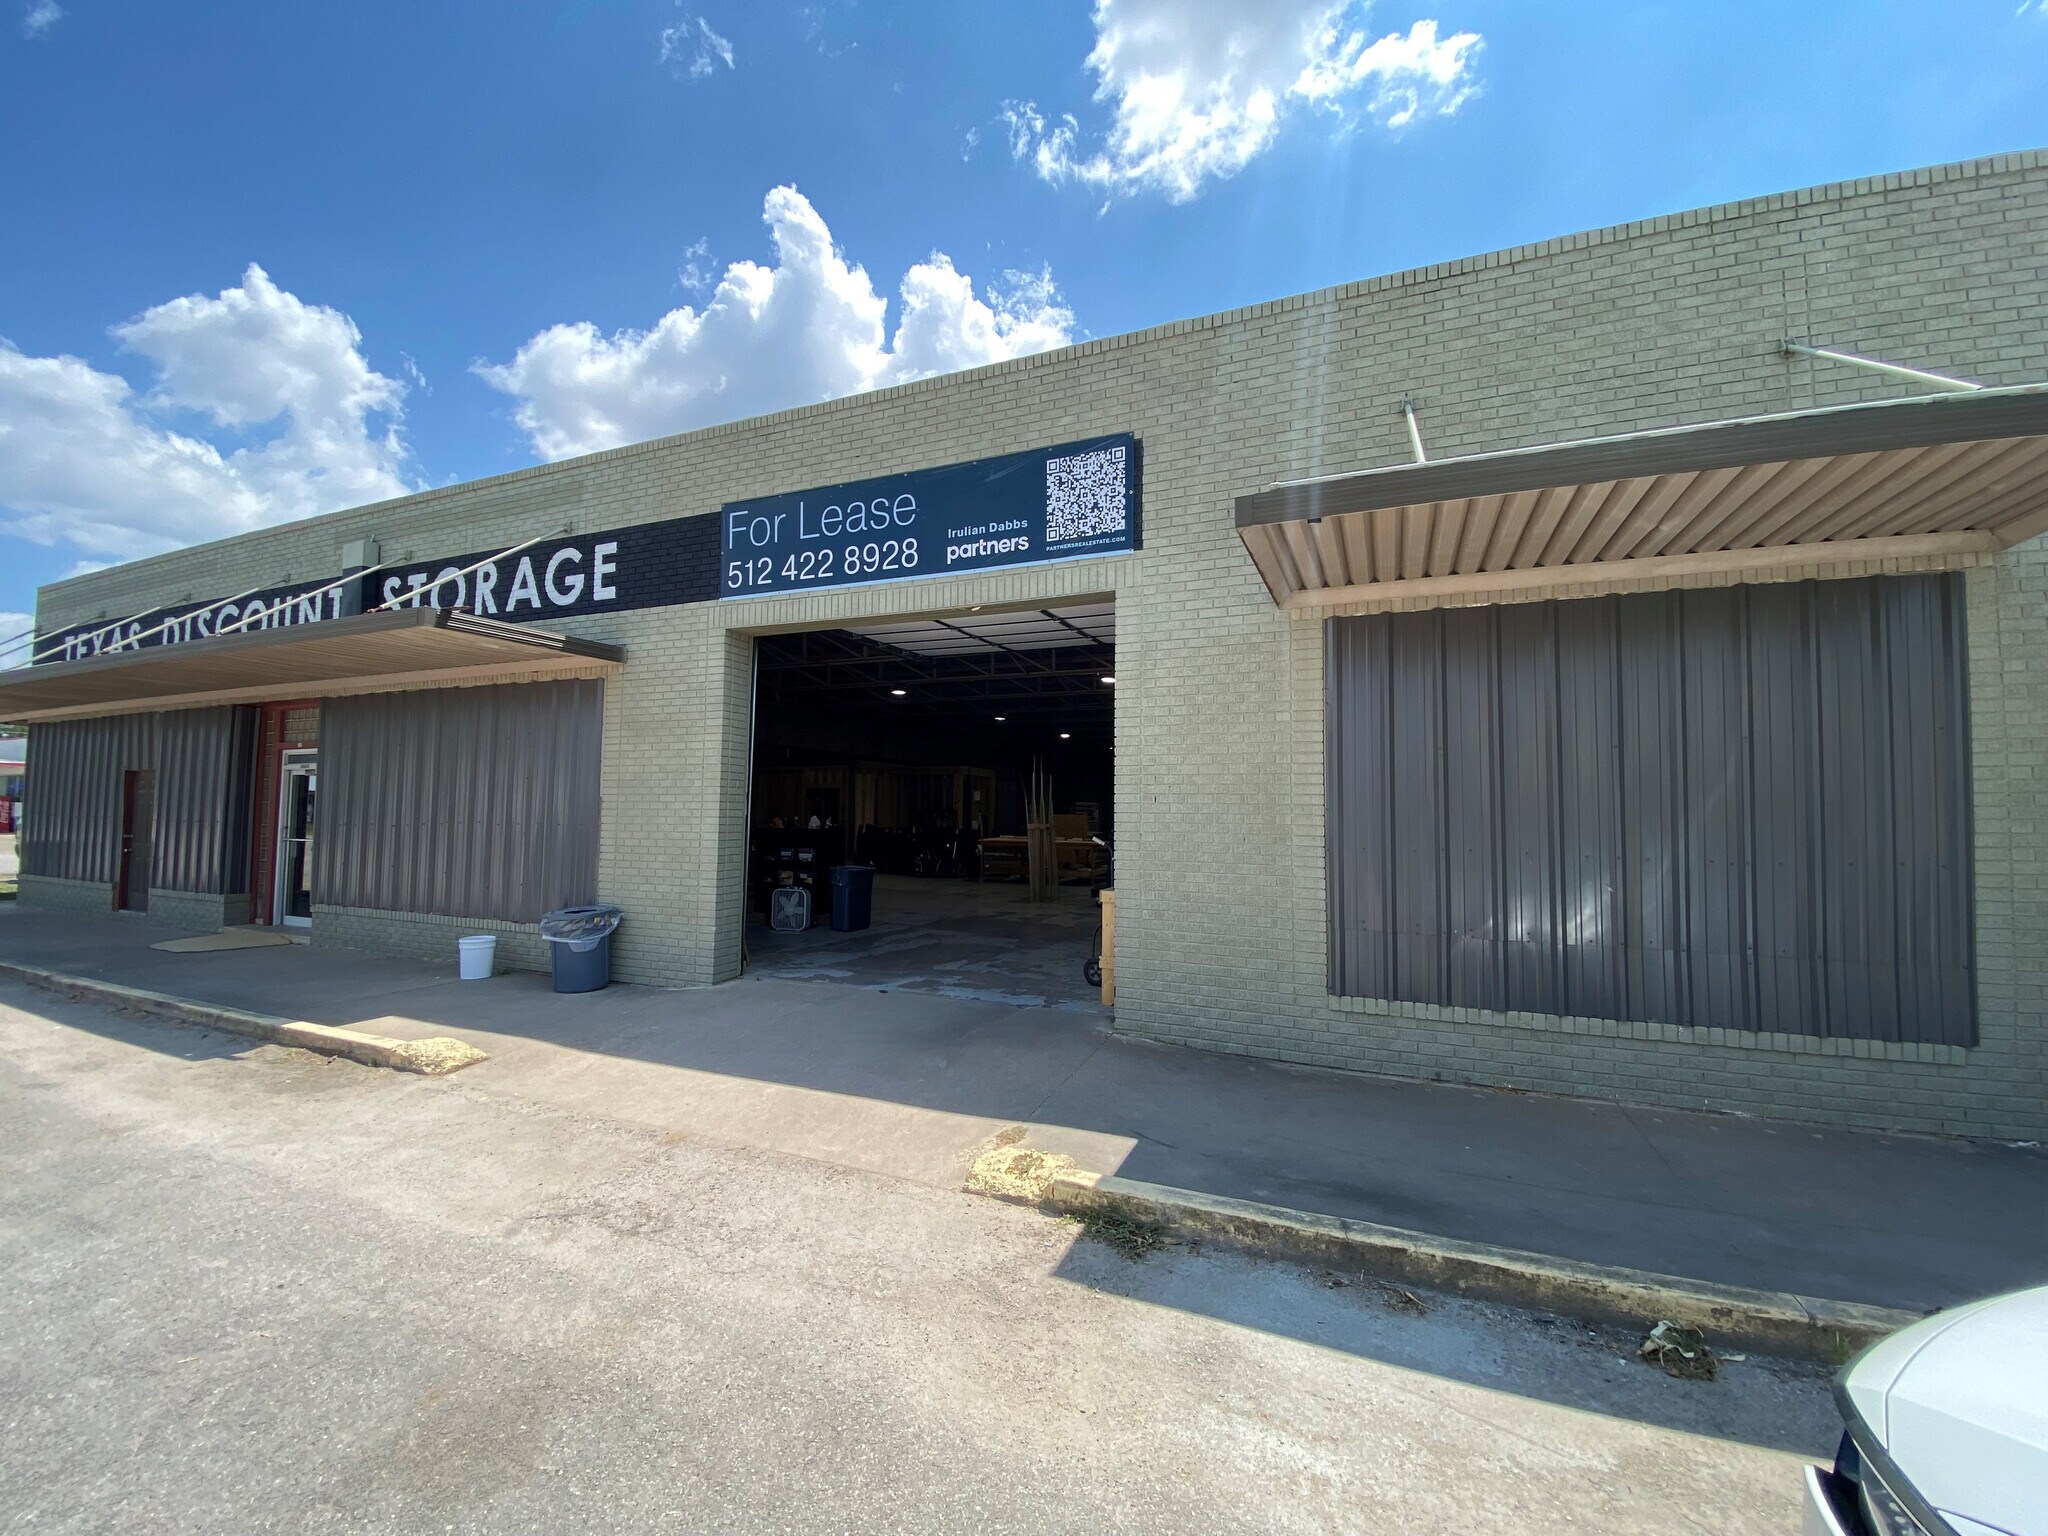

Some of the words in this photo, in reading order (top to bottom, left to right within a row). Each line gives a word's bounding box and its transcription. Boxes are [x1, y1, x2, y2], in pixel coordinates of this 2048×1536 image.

[729, 510, 786, 549] For
[799, 494, 916, 540] Lease
[989, 519, 1028, 533] Dabbs
[728, 557, 772, 589] 512
[781, 549, 834, 581] 422
[844, 538, 919, 575] 8928
[947, 536, 1029, 564] partners
[64, 622, 140, 661] TEXAS
[162, 587, 343, 646] DISCOUNT
[383, 542, 617, 615] STORAGE
